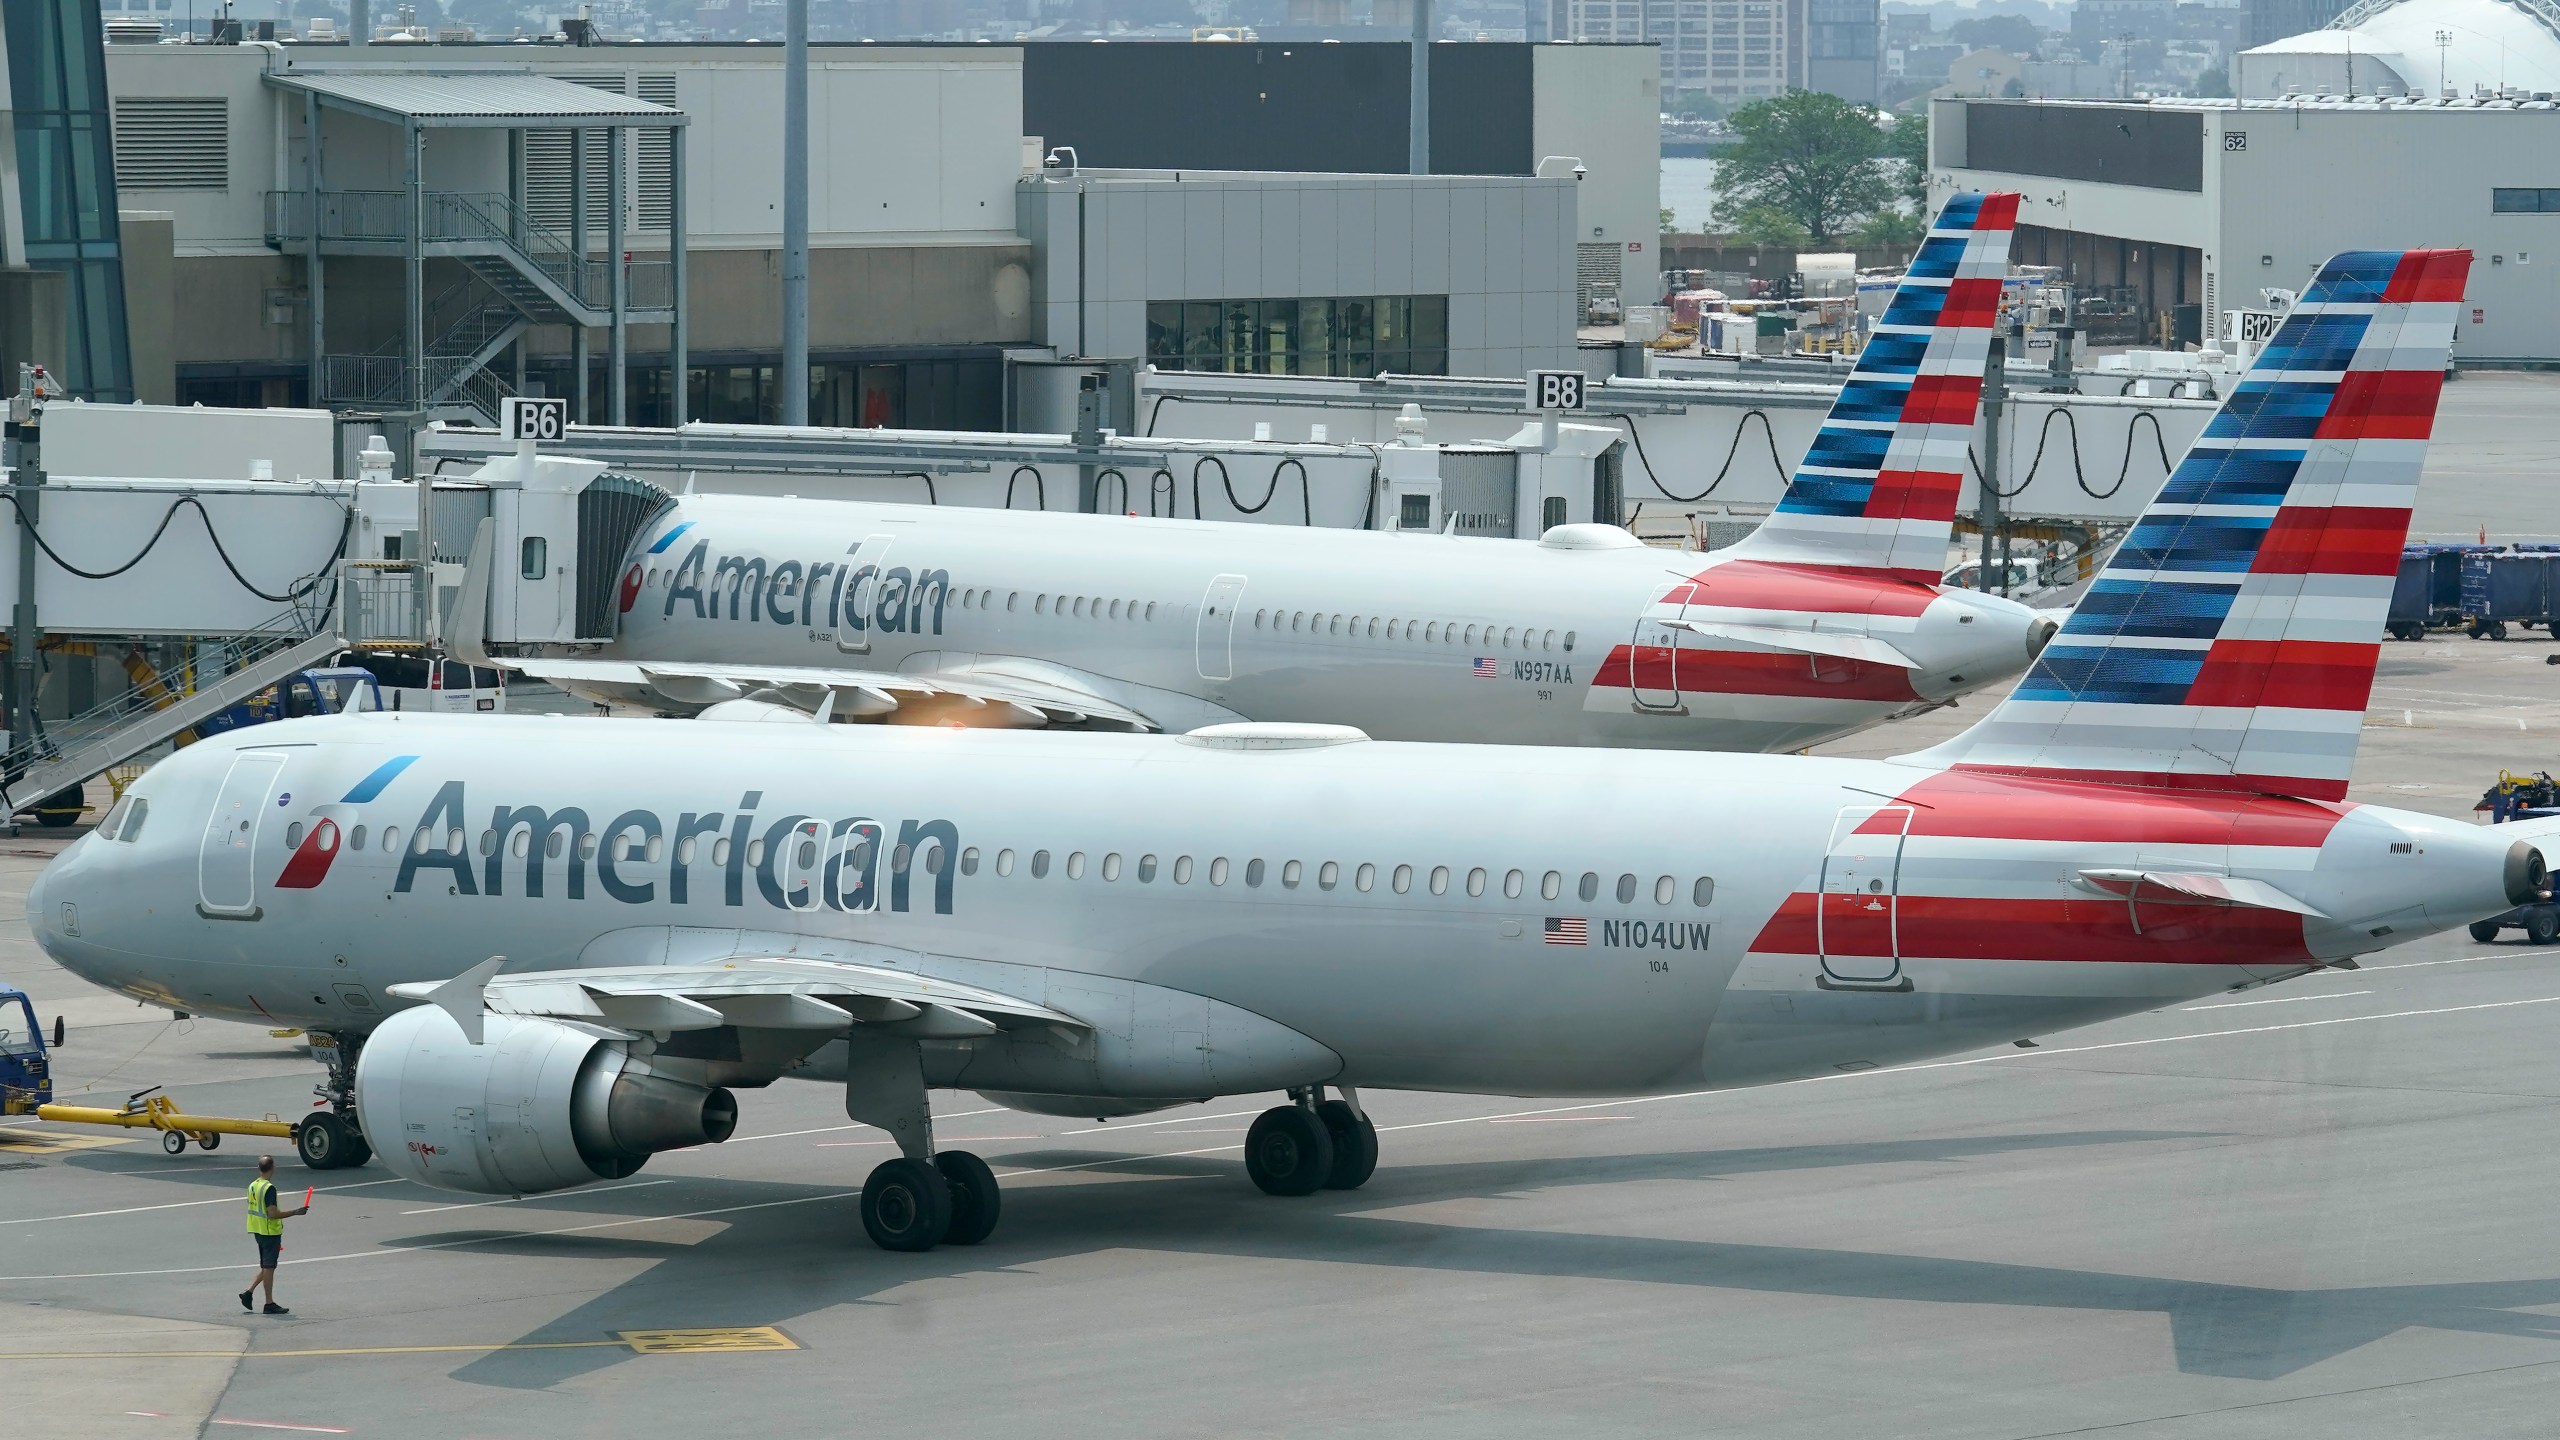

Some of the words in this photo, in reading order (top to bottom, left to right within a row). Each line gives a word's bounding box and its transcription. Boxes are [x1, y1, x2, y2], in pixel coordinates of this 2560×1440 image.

[2225, 136, 2245, 150] 62
[2243, 314, 2270, 341] B12
[1543, 375, 1577, 408] B8
[520, 403, 557, 439] B6
[664, 538, 950, 636] American
[816, 633, 832, 642] A321
[1514, 660, 1573, 684] N997AA
[1537, 690, 1552, 701] 997
[393, 780, 959, 915] American
[1603, 919, 1711, 951] N104UW
[1649, 960, 1669, 973] 104
[309, 1034, 336, 1048] A320
[317, 1051, 335, 1061] 104
